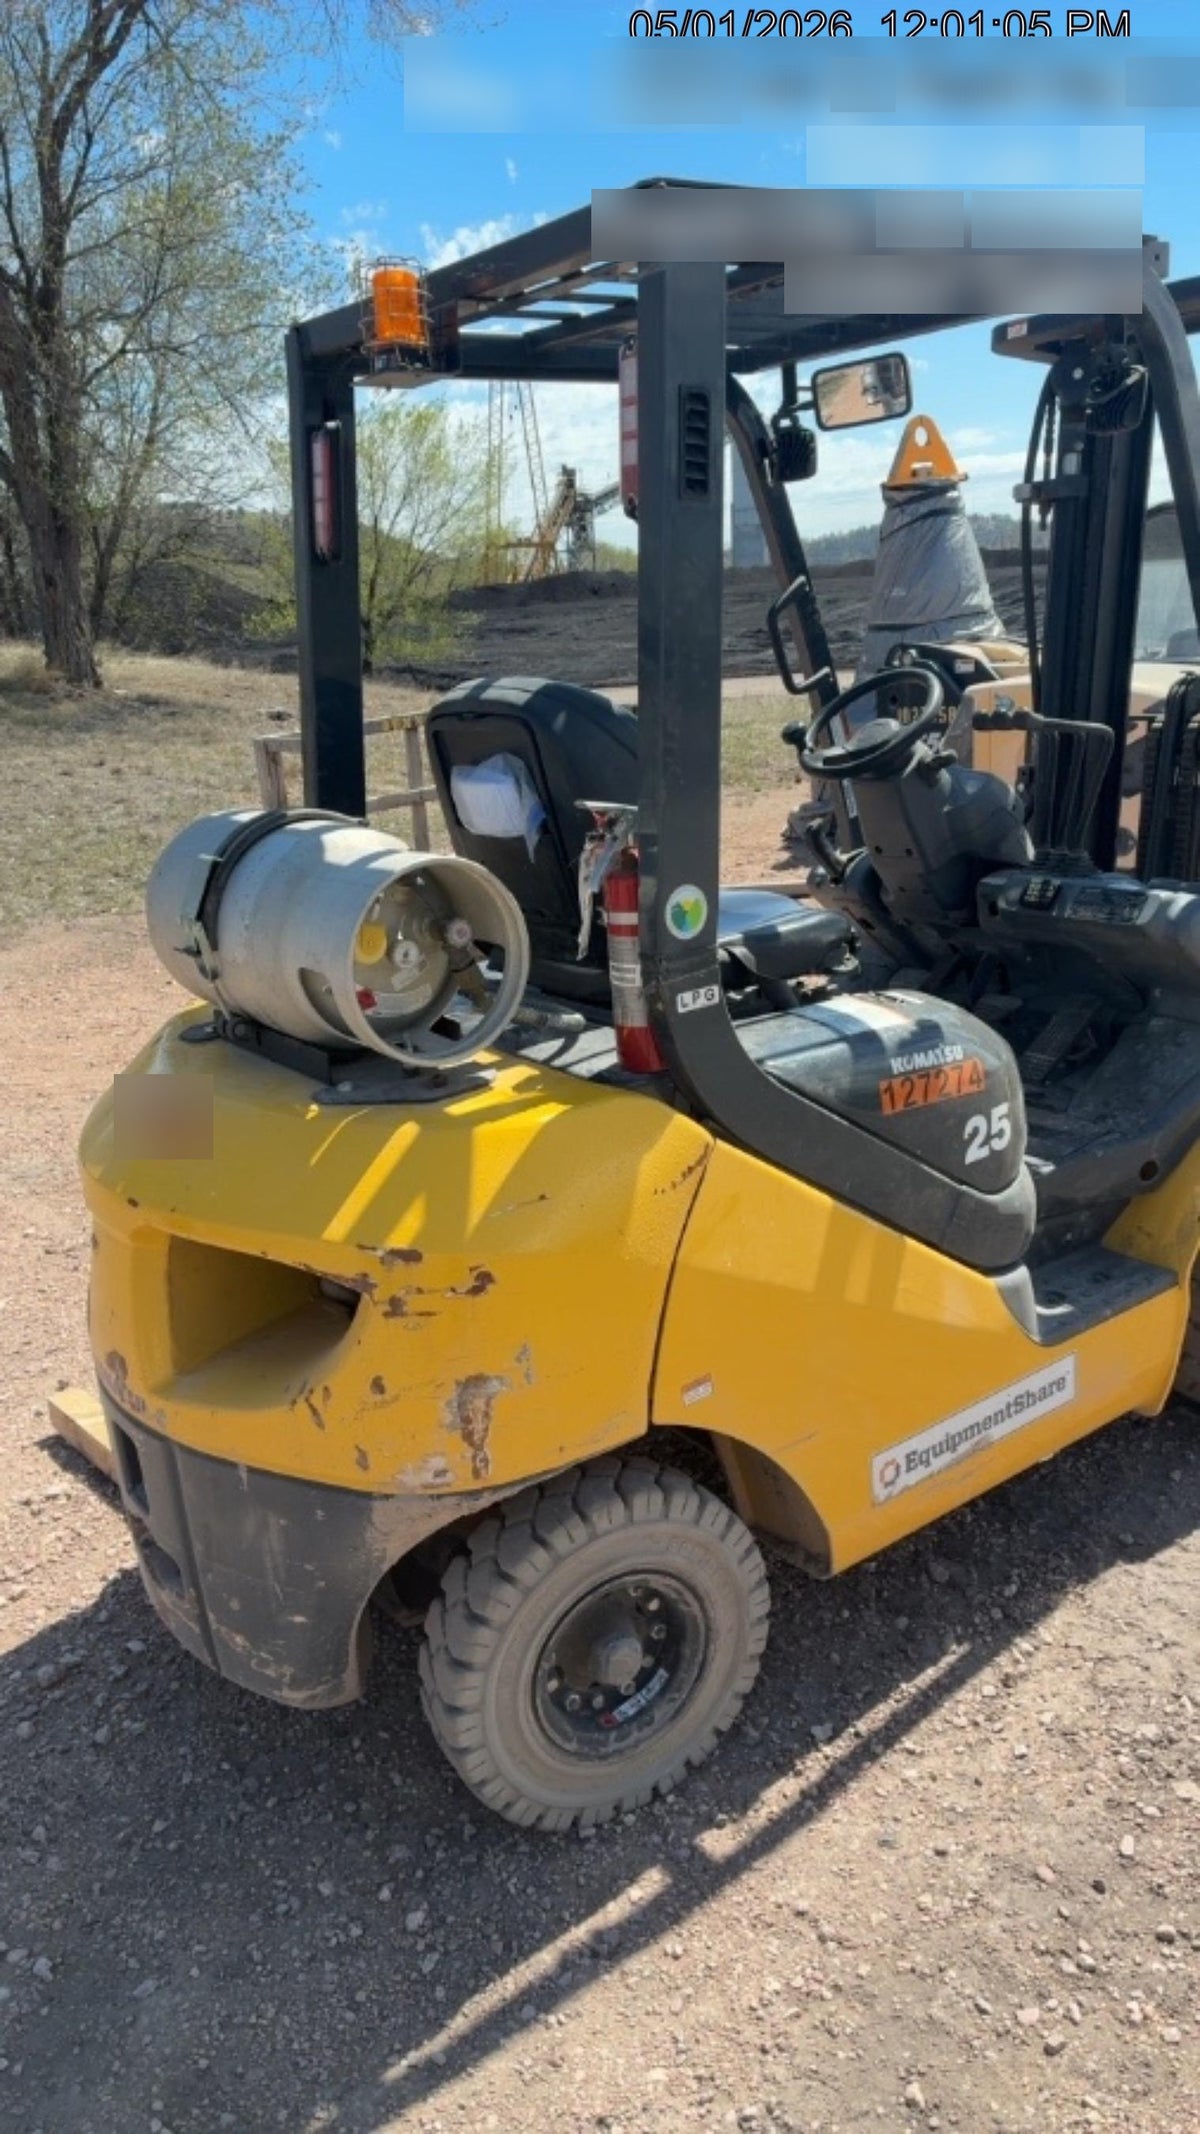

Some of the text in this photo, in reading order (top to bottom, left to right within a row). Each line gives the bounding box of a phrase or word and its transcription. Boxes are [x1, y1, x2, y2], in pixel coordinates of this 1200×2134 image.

[680, 987, 716, 1009] LPG
[883, 1058, 983, 1111] 127274
[890, 1044, 964, 1074] KOMATSU
[963, 1102, 1011, 1165] 25
[904, 1375, 1067, 1474] EquipmentShare
